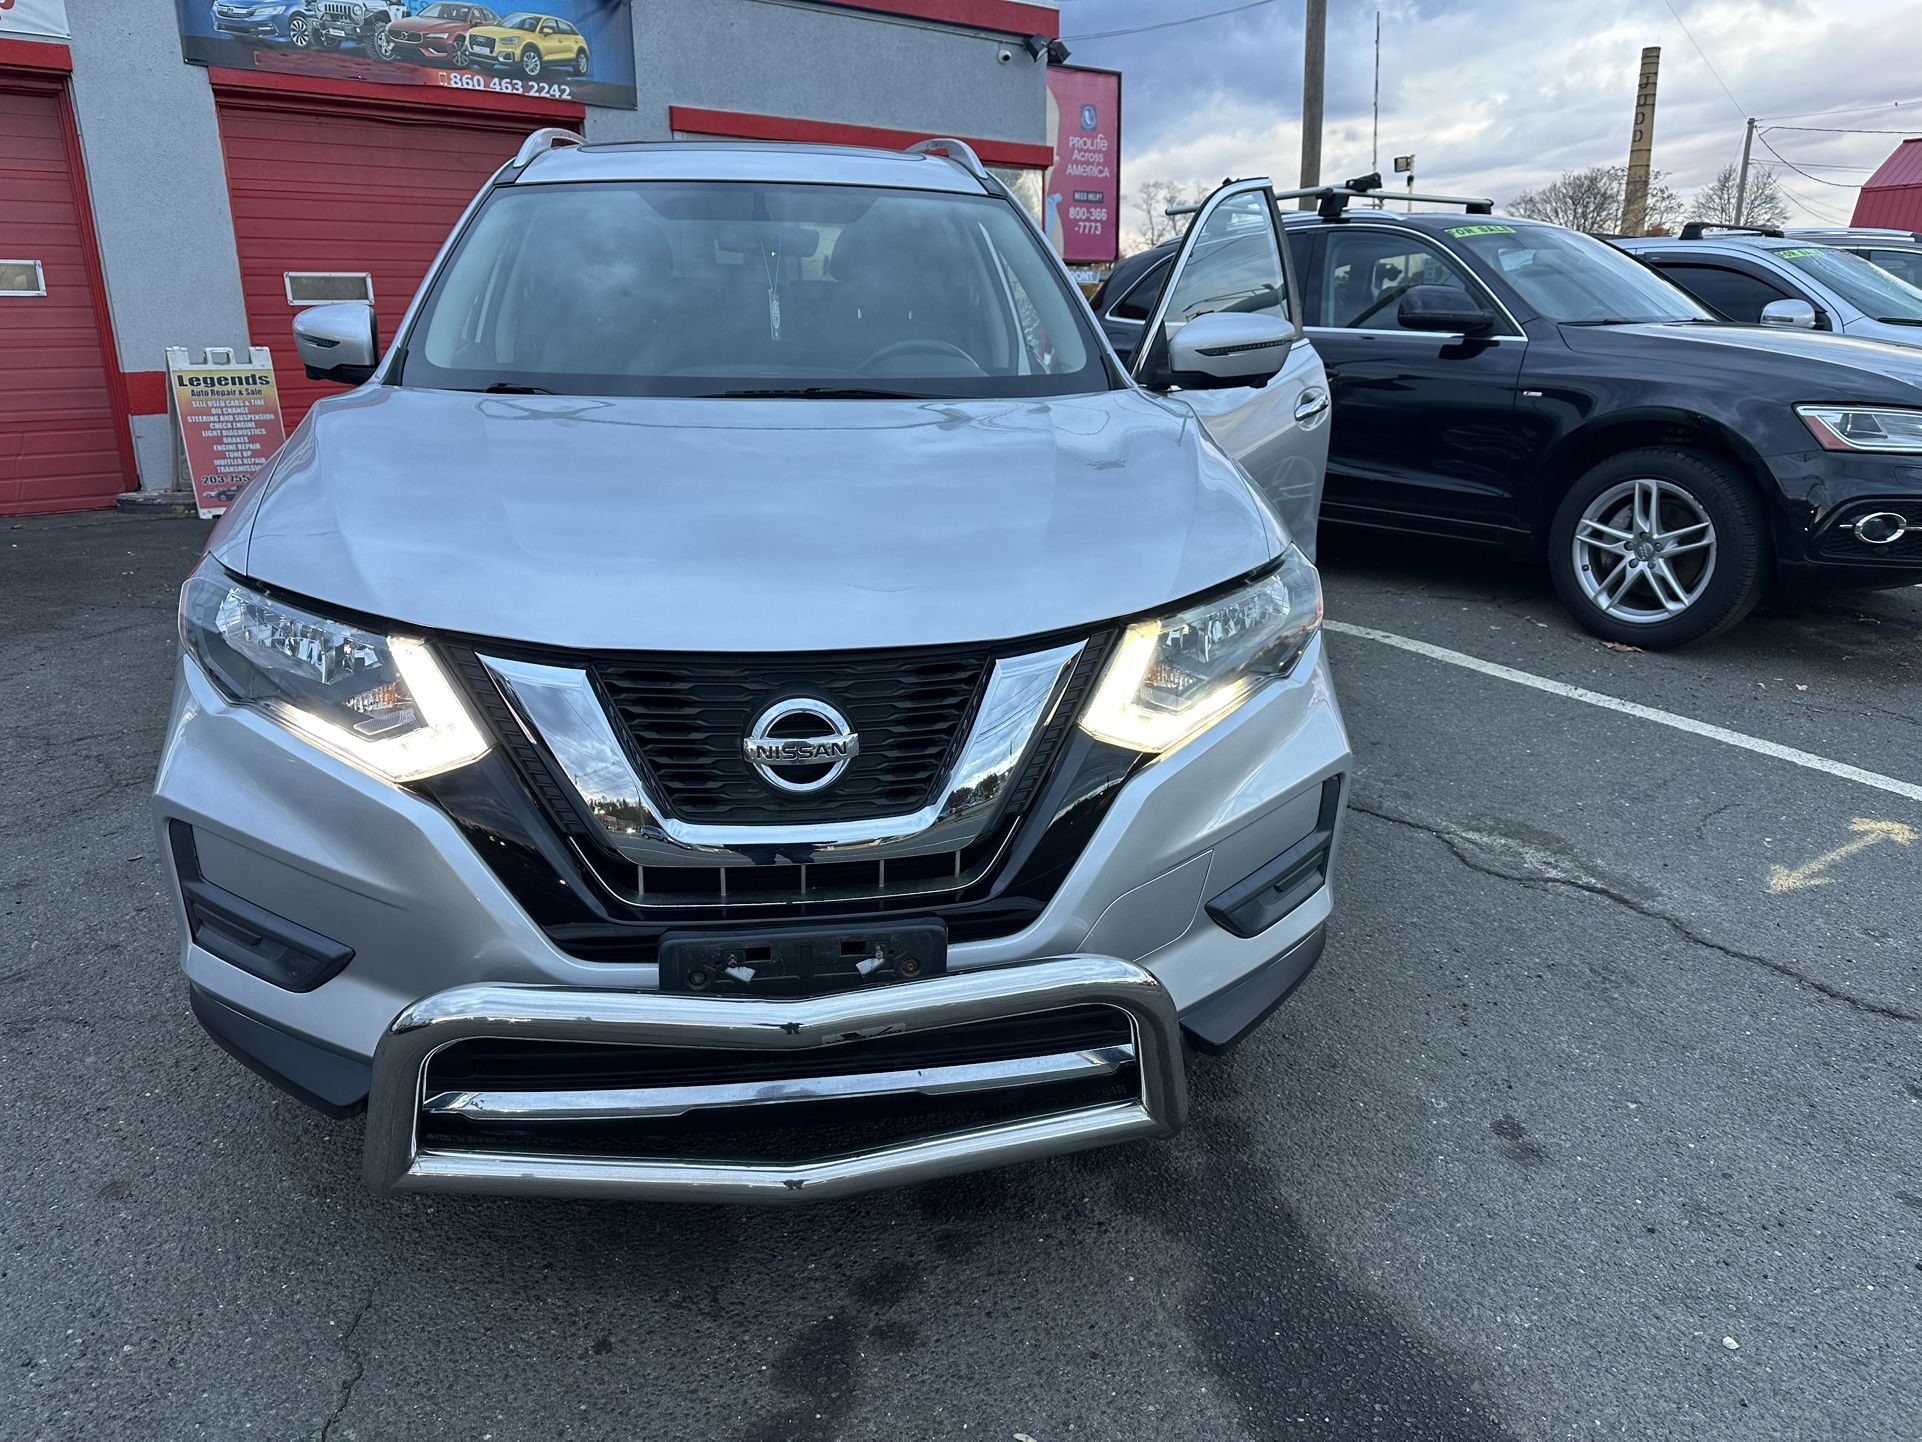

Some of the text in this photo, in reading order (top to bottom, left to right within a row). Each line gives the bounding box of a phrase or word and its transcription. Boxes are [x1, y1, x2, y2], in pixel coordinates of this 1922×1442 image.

[450, 72, 571, 99] 860 463 2242
[1633, 75, 1651, 143] JUDD
[1071, 149, 1104, 162] Across
[1074, 192, 1087, 200] NEED
[1068, 206, 1108, 220] 800-366
[1074, 221, 1102, 235] -7773
[176, 374, 271, 388] Legends
[210, 389, 237, 397] Repair
[245, 388, 263, 397] Sale
[187, 415, 219, 423] STEERING
[234, 413, 275, 421] SUSPENSION
[222, 428, 266, 436] DIAGNOSTICS
[222, 436, 249, 444] BRAKES
[213, 458, 242, 466] MUFFLER
[201, 475, 225, 485] 203
[756, 741, 848, 760] NISSAN
